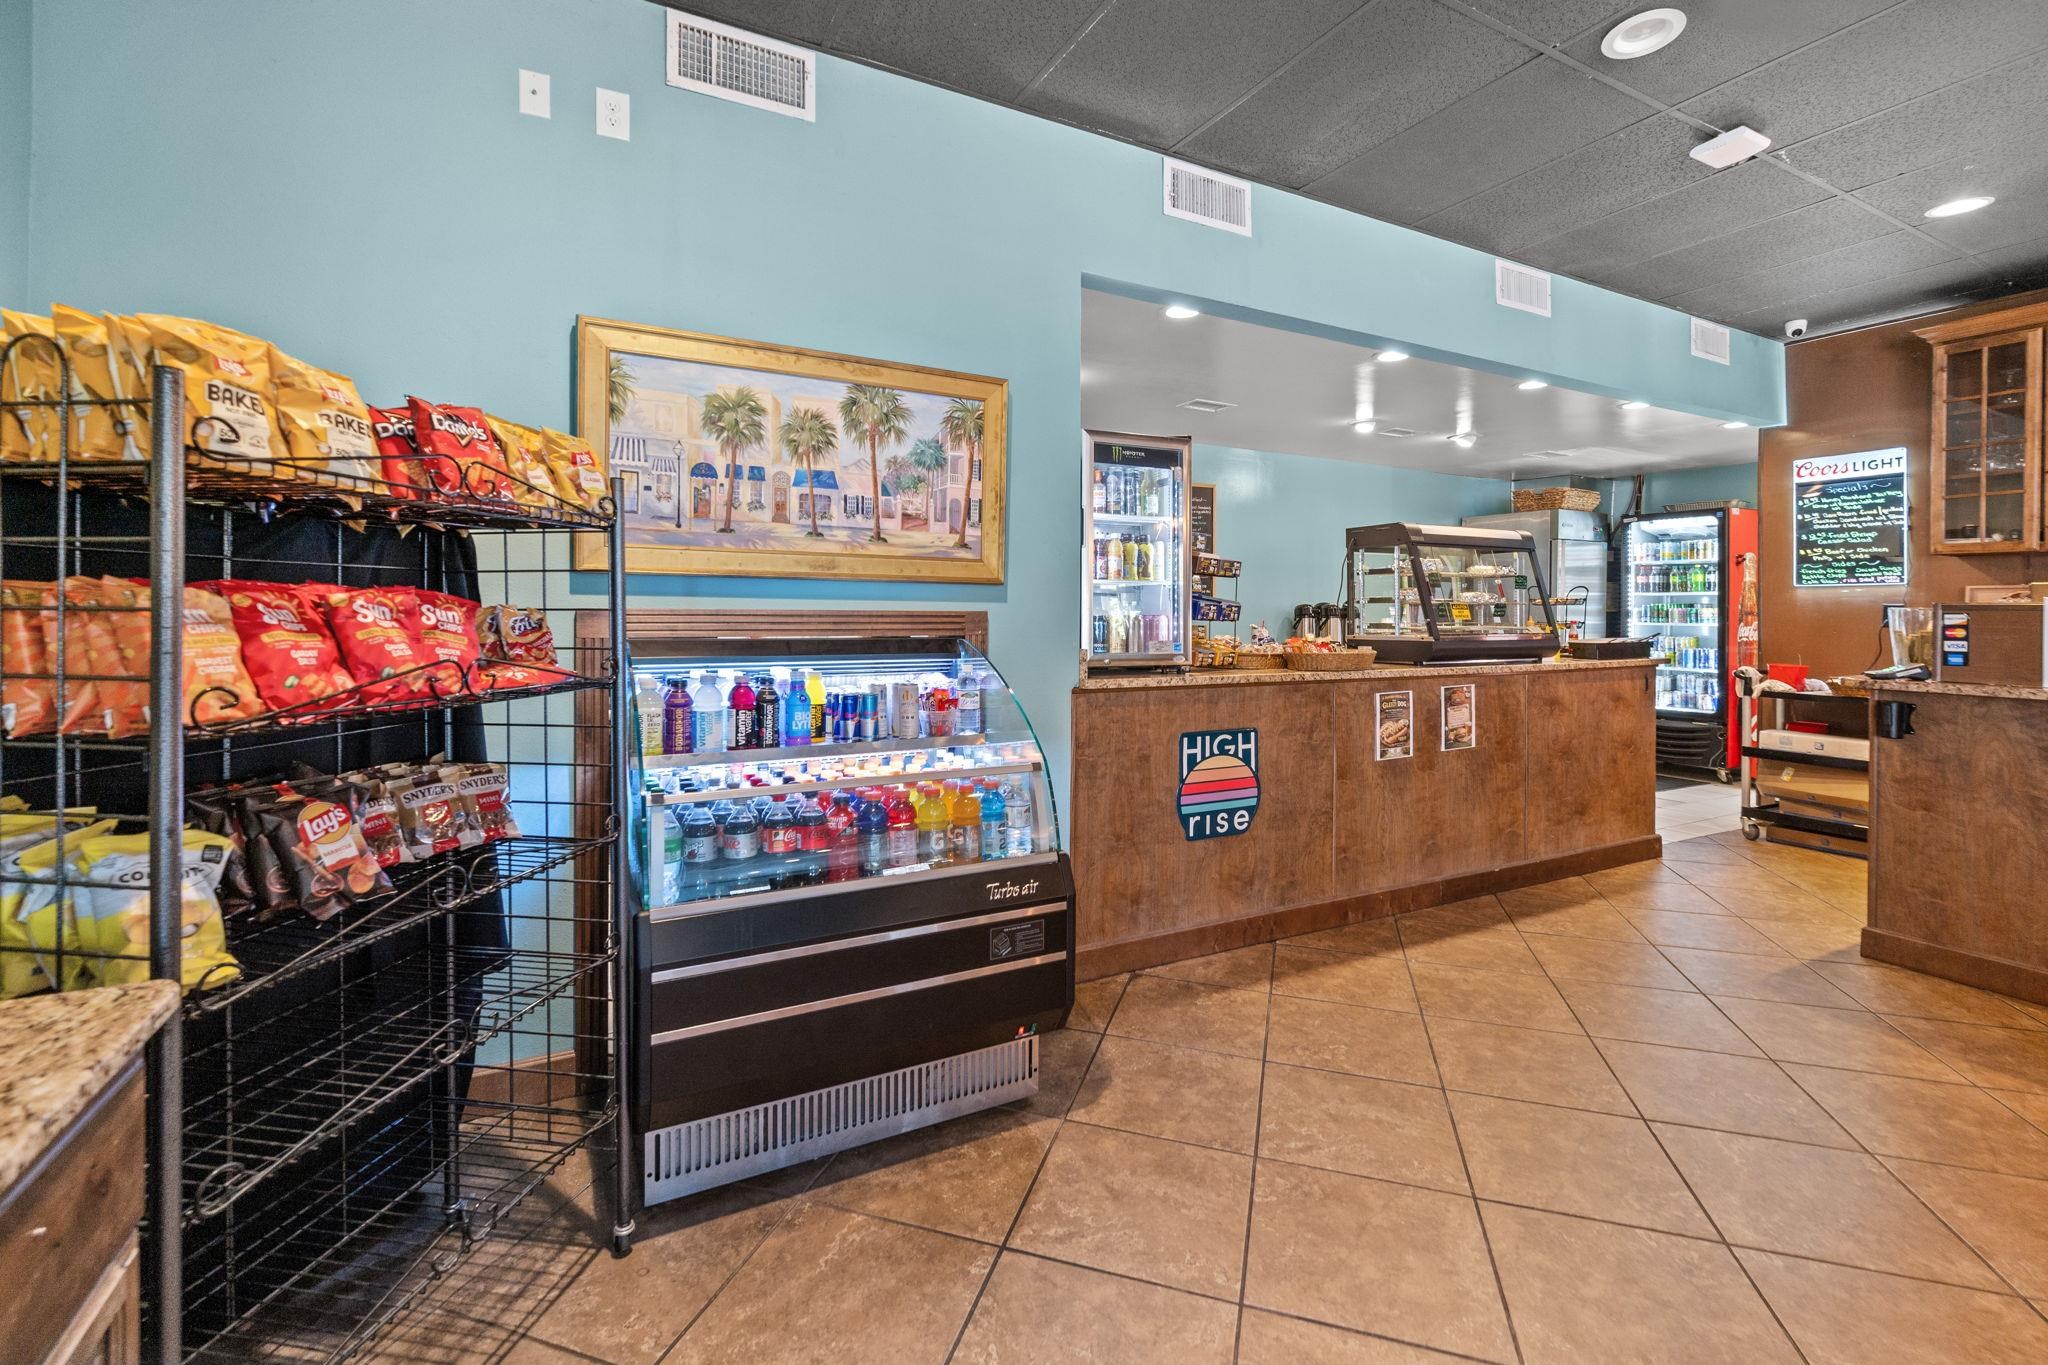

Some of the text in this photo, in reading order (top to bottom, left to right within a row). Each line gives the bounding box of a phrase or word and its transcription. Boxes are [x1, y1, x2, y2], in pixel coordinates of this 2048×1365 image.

[432, 413, 488, 442] Doritos
[1795, 456, 1904, 478] Coors LIGHT
[352, 599, 392, 623] Sun
[420, 604, 461, 626] Sun
[437, 622, 464, 634] CHIPS
[1946, 642, 1966, 650] VISA
[675, 708, 684, 751] BODYARMOR
[737, 709, 745, 746] vitamin
[744, 709, 752, 734] water
[765, 704, 774, 745] BODYARMOR
[1182, 731, 1256, 780] HIGH
[459, 774, 508, 790] SNYDER'S
[303, 807, 348, 842] Lay's
[1189, 809, 1250, 838] rise
[1021, 879, 1039, 895] air
